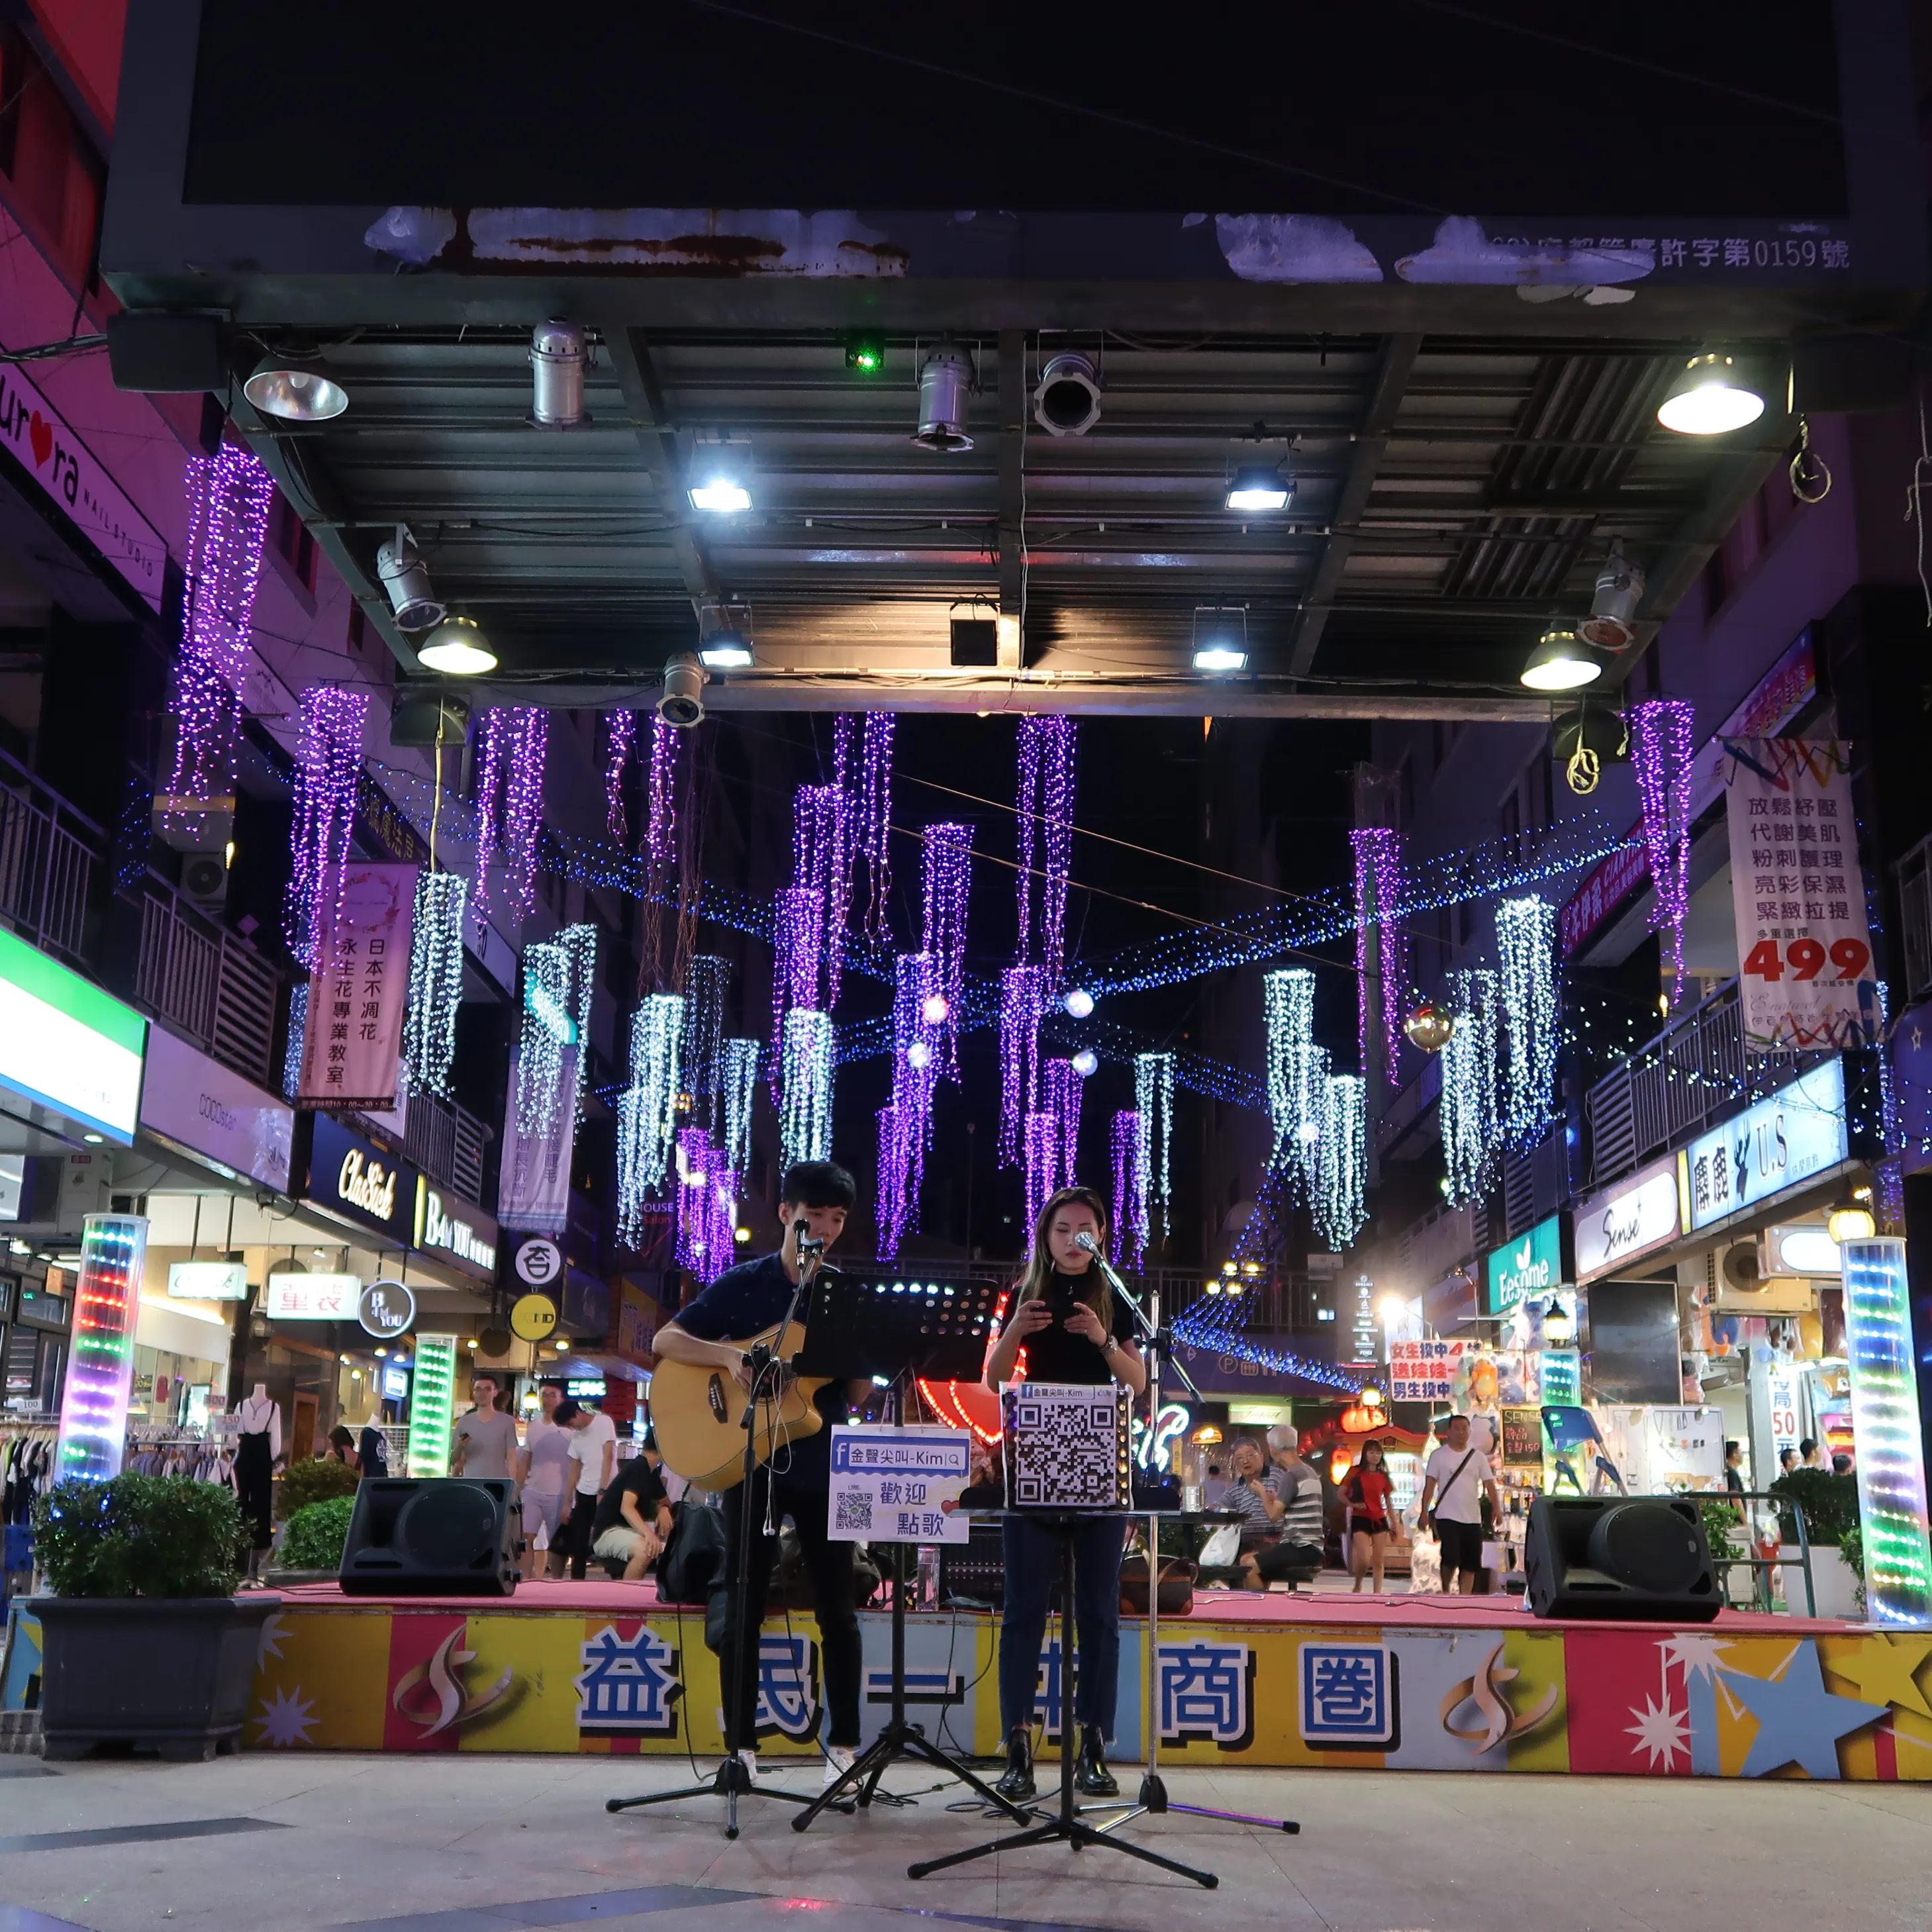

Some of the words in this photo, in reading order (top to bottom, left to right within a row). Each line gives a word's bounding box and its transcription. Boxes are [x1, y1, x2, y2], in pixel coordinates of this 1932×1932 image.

[83, 488, 109, 529] NAIL
[114, 524, 153, 577] STUDIO
[1749, 798, 1838, 817] 放鬆紓壓
[1751, 823, 1840, 843] 代謝美肌
[1753, 849, 1843, 869] 粉刺護理
[1755, 875, 1847, 894] 亮彩保濕
[1757, 901, 1849, 921] 緊緻拉提
[1757, 928, 1809, 940] 多重選擇
[1743, 938, 1870, 982] 499
[359, 939, 385, 1041] 日本不凋花
[326, 938, 358, 1084] 永生花專業教室
[24, 1400, 38, 1409] 100
[1504, 1410, 1542, 1424] SENSE
[880, 1482, 927, 1506] 歡迎
[896, 1513, 944, 1536] 點歌
